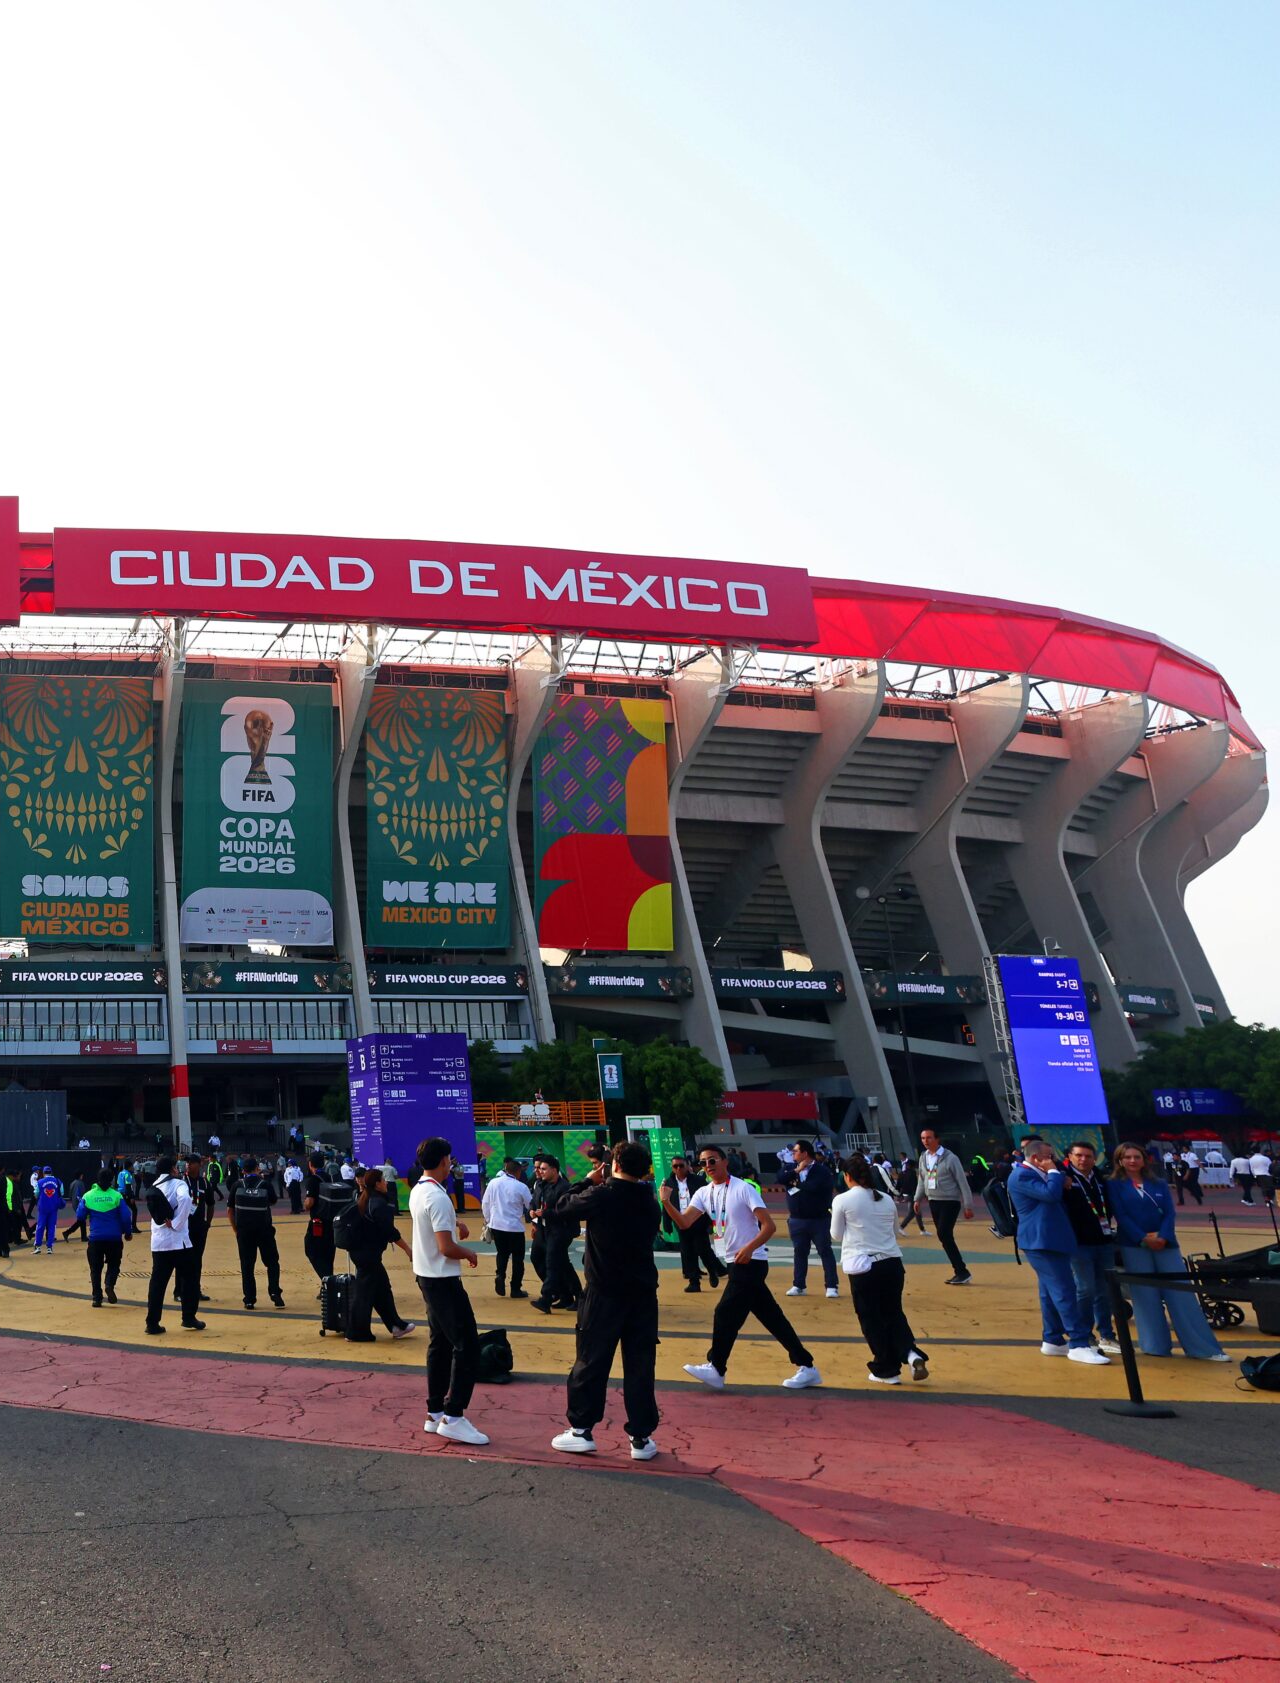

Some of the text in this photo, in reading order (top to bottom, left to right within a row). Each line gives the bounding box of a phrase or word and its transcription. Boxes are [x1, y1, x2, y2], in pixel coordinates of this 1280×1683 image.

[110, 550, 769, 616] CIUDAD DE MÉXICO
[242, 789, 276, 802] FIFA
[220, 817, 296, 839] COPA
[219, 840, 296, 855] MUNDIAL
[219, 856, 296, 875] 2026
[21, 874, 130, 898] SOMOS
[382, 880, 497, 904] WE ARE
[21, 902, 129, 918] CIUDAD DE
[382, 906, 496, 924] MEXICO CITY
[21, 917, 130, 936] MÉXICO
[12, 972, 144, 981] FIFA WORLD CUP 2026
[235, 972, 299, 984] #FIFAWorldCup
[385, 974, 507, 984] FIFA WORLD CUP 2026
[588, 976, 645, 987] #FIFAWorldCup
[721, 978, 827, 990] FIFA WORLD CUP 2026
[897, 983, 945, 995] #FIFAWorldCup
[85, 1044, 91, 1052] 4
[221, 1043, 228, 1051] 4
[1156, 1096, 1174, 1108] 18
[1179, 1099, 1192, 1112] 18
